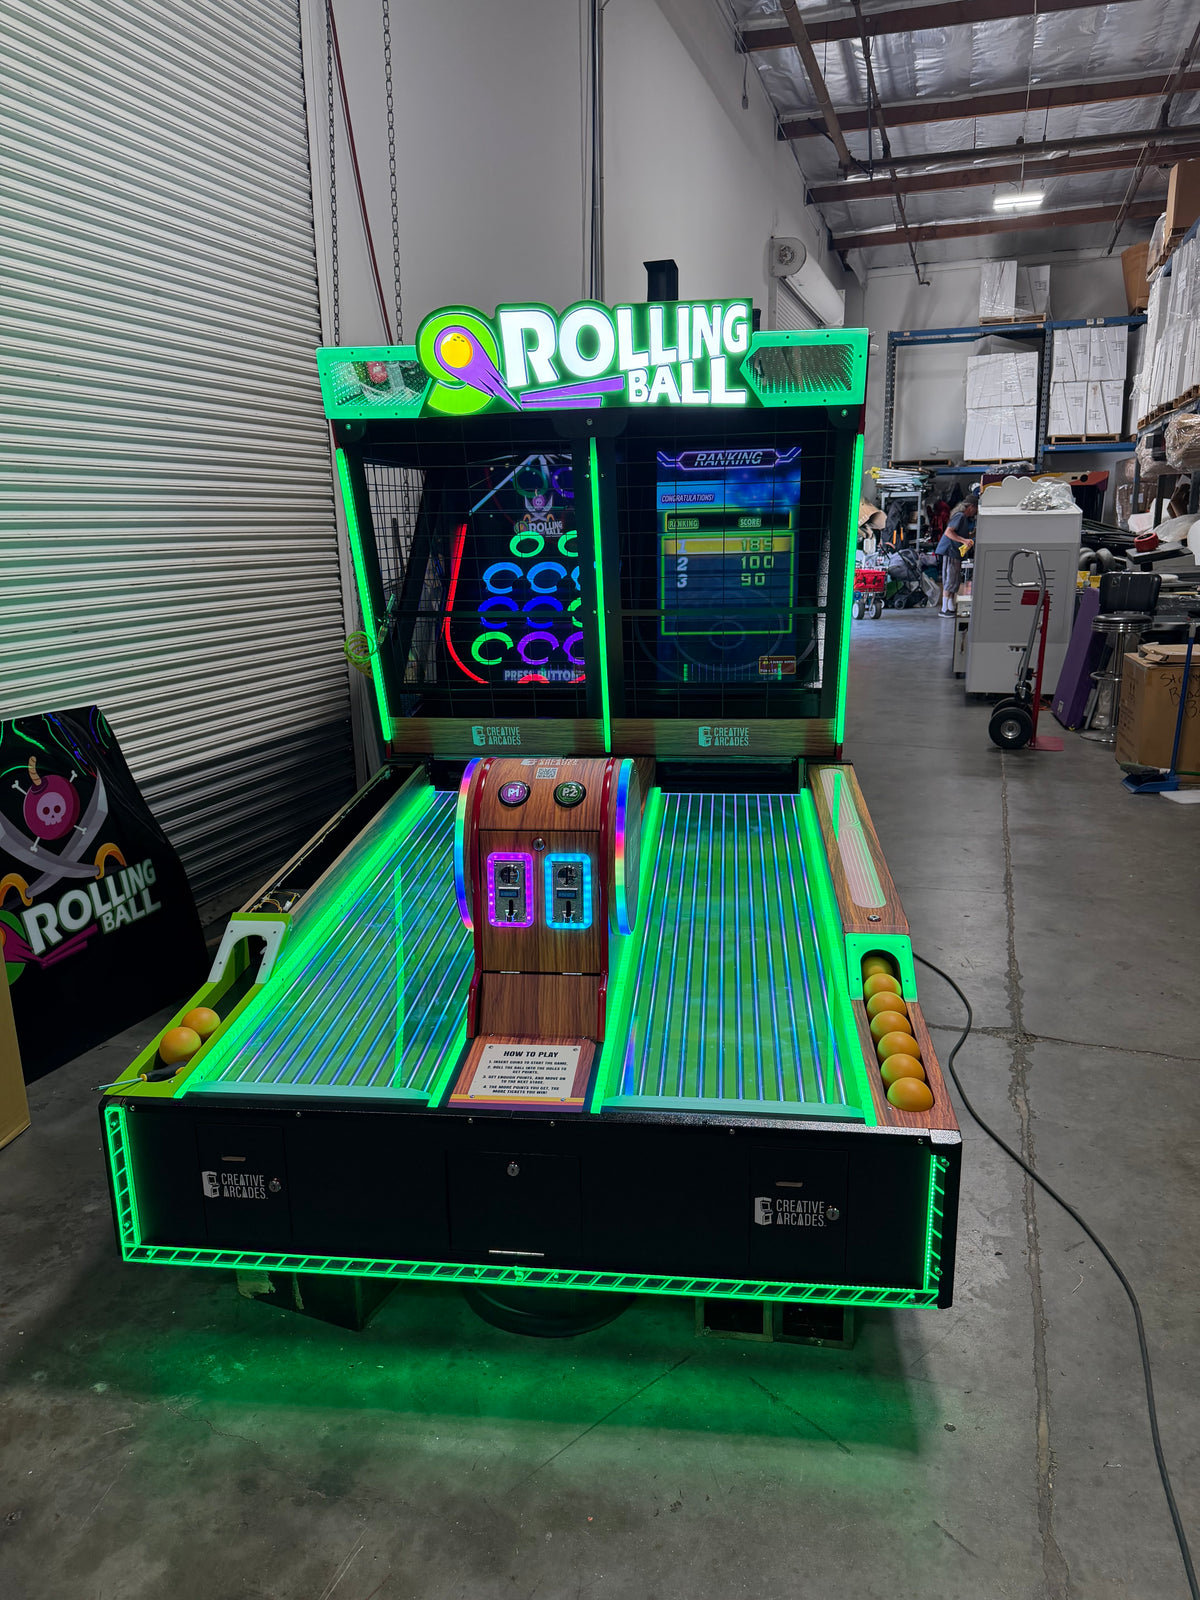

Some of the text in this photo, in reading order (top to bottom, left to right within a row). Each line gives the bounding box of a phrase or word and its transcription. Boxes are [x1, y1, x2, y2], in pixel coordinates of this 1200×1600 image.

[500, 303, 748, 388] ROLLING
[628, 356, 747, 404] BALL
[694, 451, 763, 467] RANKING
[660, 494, 714, 503] CONGRATULATIONS!
[528, 521, 562, 532] ROLLING
[669, 520, 698, 528] RANKING
[740, 518, 760, 527] SCORE
[677, 540, 687, 553] 1
[742, 538, 772, 552] 185
[677, 557, 688, 571] 2
[742, 556, 774, 569] 100
[677, 574, 688, 588] 3
[741, 573, 765, 586] 90
[486, 726, 520, 736] CREATIVE
[714, 727, 749, 736] CREATIVE
[488, 736, 521, 745] ARCADES
[714, 736, 749, 746] ARCADES
[21, 859, 156, 955] ROLLING
[102, 888, 161, 933] BALL
[221, 1173, 264, 1187] CREATIVE
[224, 1186, 266, 1199] ARCADES
[776, 1199, 825, 1214] CREATIVE
[776, 1213, 824, 1227] ARCADES
